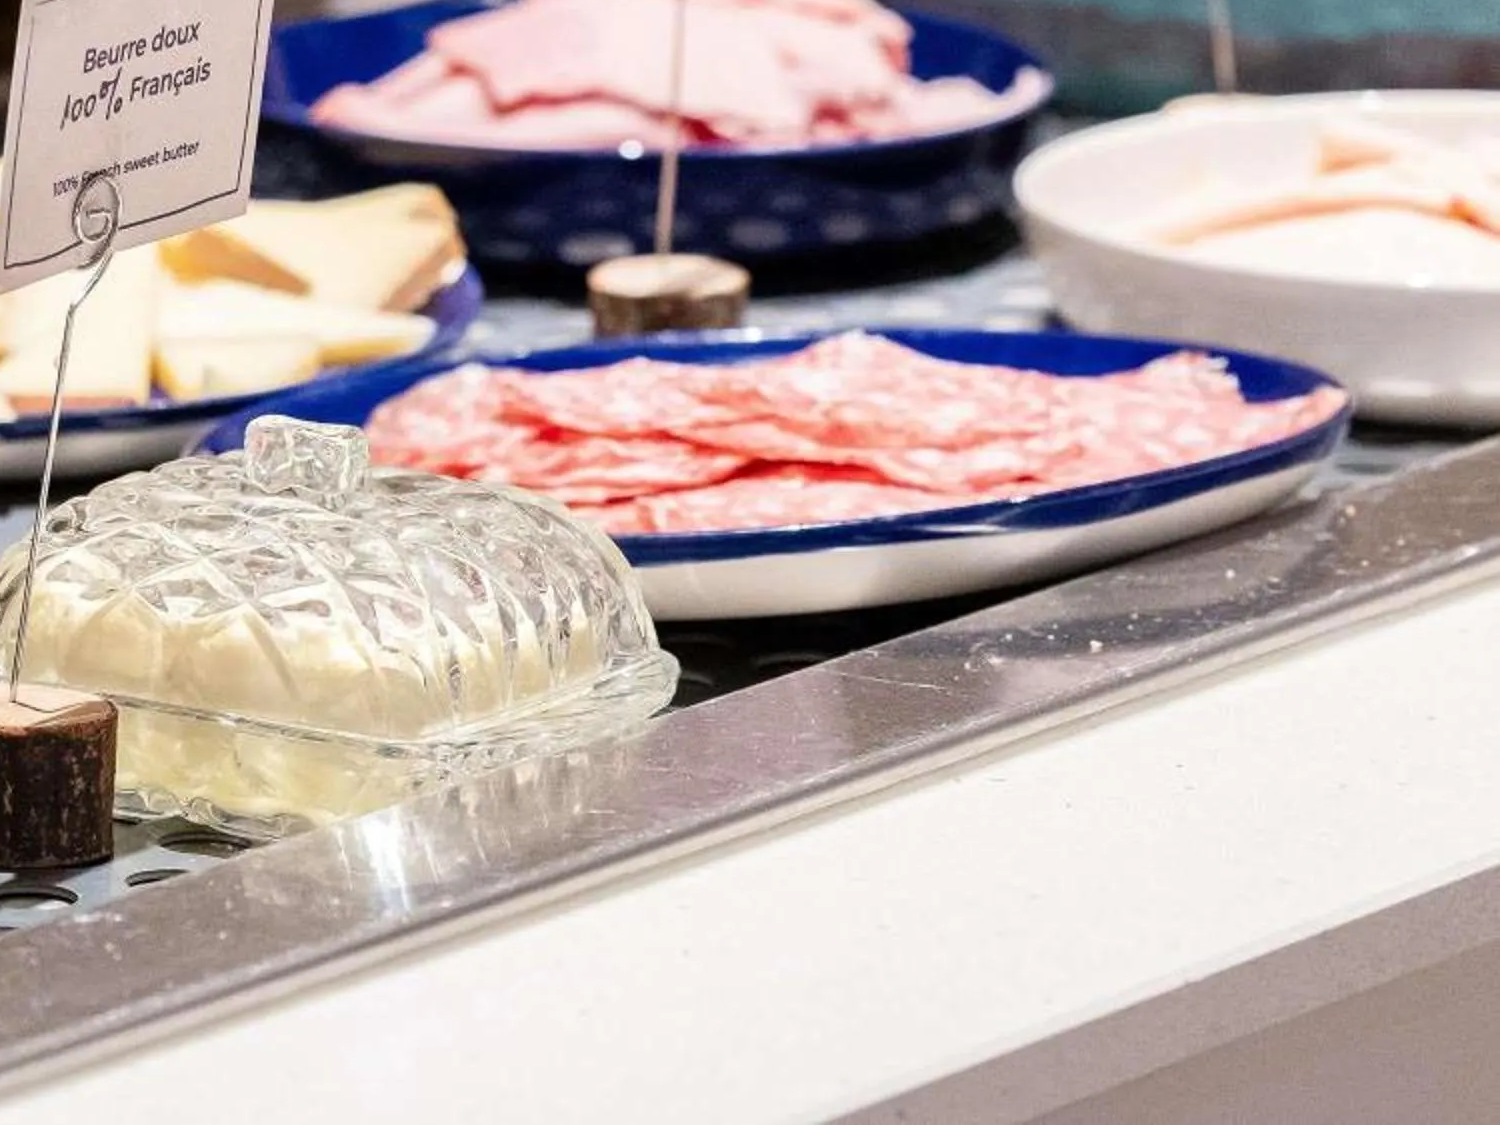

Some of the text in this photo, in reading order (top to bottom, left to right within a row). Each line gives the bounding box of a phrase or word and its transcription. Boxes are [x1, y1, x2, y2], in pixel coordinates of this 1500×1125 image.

[83, 21, 201, 74] Beurre doux
[60, 55, 212, 131] 100% Français
[53, 176, 79, 197] 100%
[124, 152, 161, 174] sweet
[163, 141, 200, 162] butter
